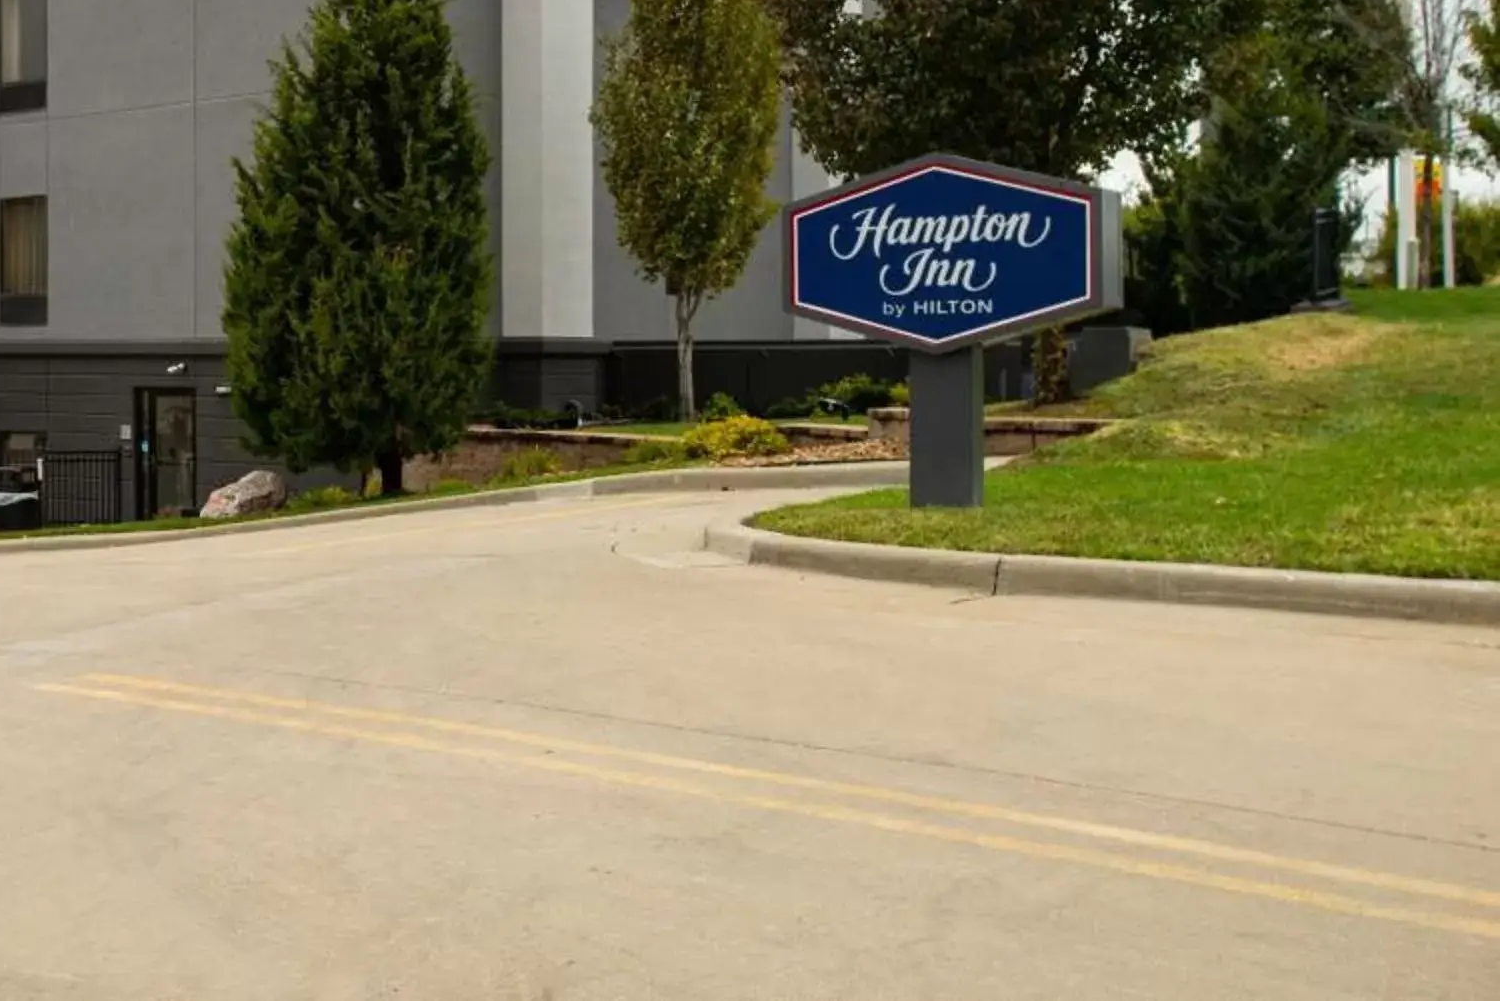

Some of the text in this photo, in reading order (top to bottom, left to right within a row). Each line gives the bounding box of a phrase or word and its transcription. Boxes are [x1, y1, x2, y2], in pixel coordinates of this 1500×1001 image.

[829, 203, 1051, 260] Hampton
[879, 248, 997, 296] Inn
[882, 299, 993, 318] by HILTON
